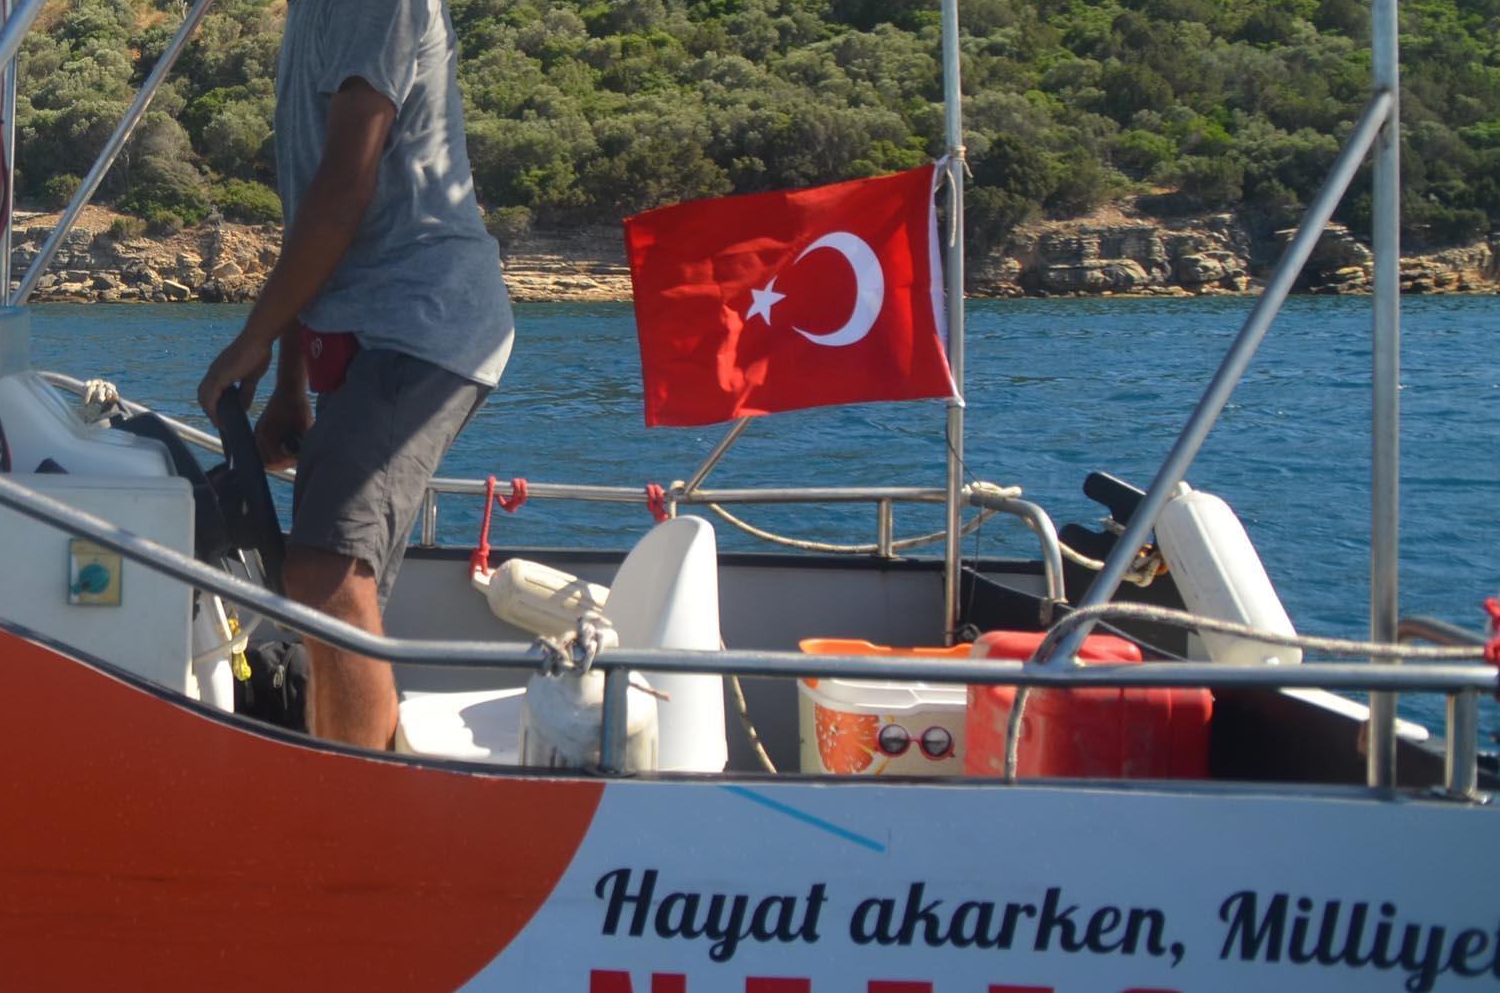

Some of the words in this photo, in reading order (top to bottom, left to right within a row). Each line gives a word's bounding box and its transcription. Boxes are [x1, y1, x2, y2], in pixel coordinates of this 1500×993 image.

[594, 868, 829, 963] Hayat
[849, 881, 1186, 969] akarken,
[1218, 890, 1500, 993] Milliye
